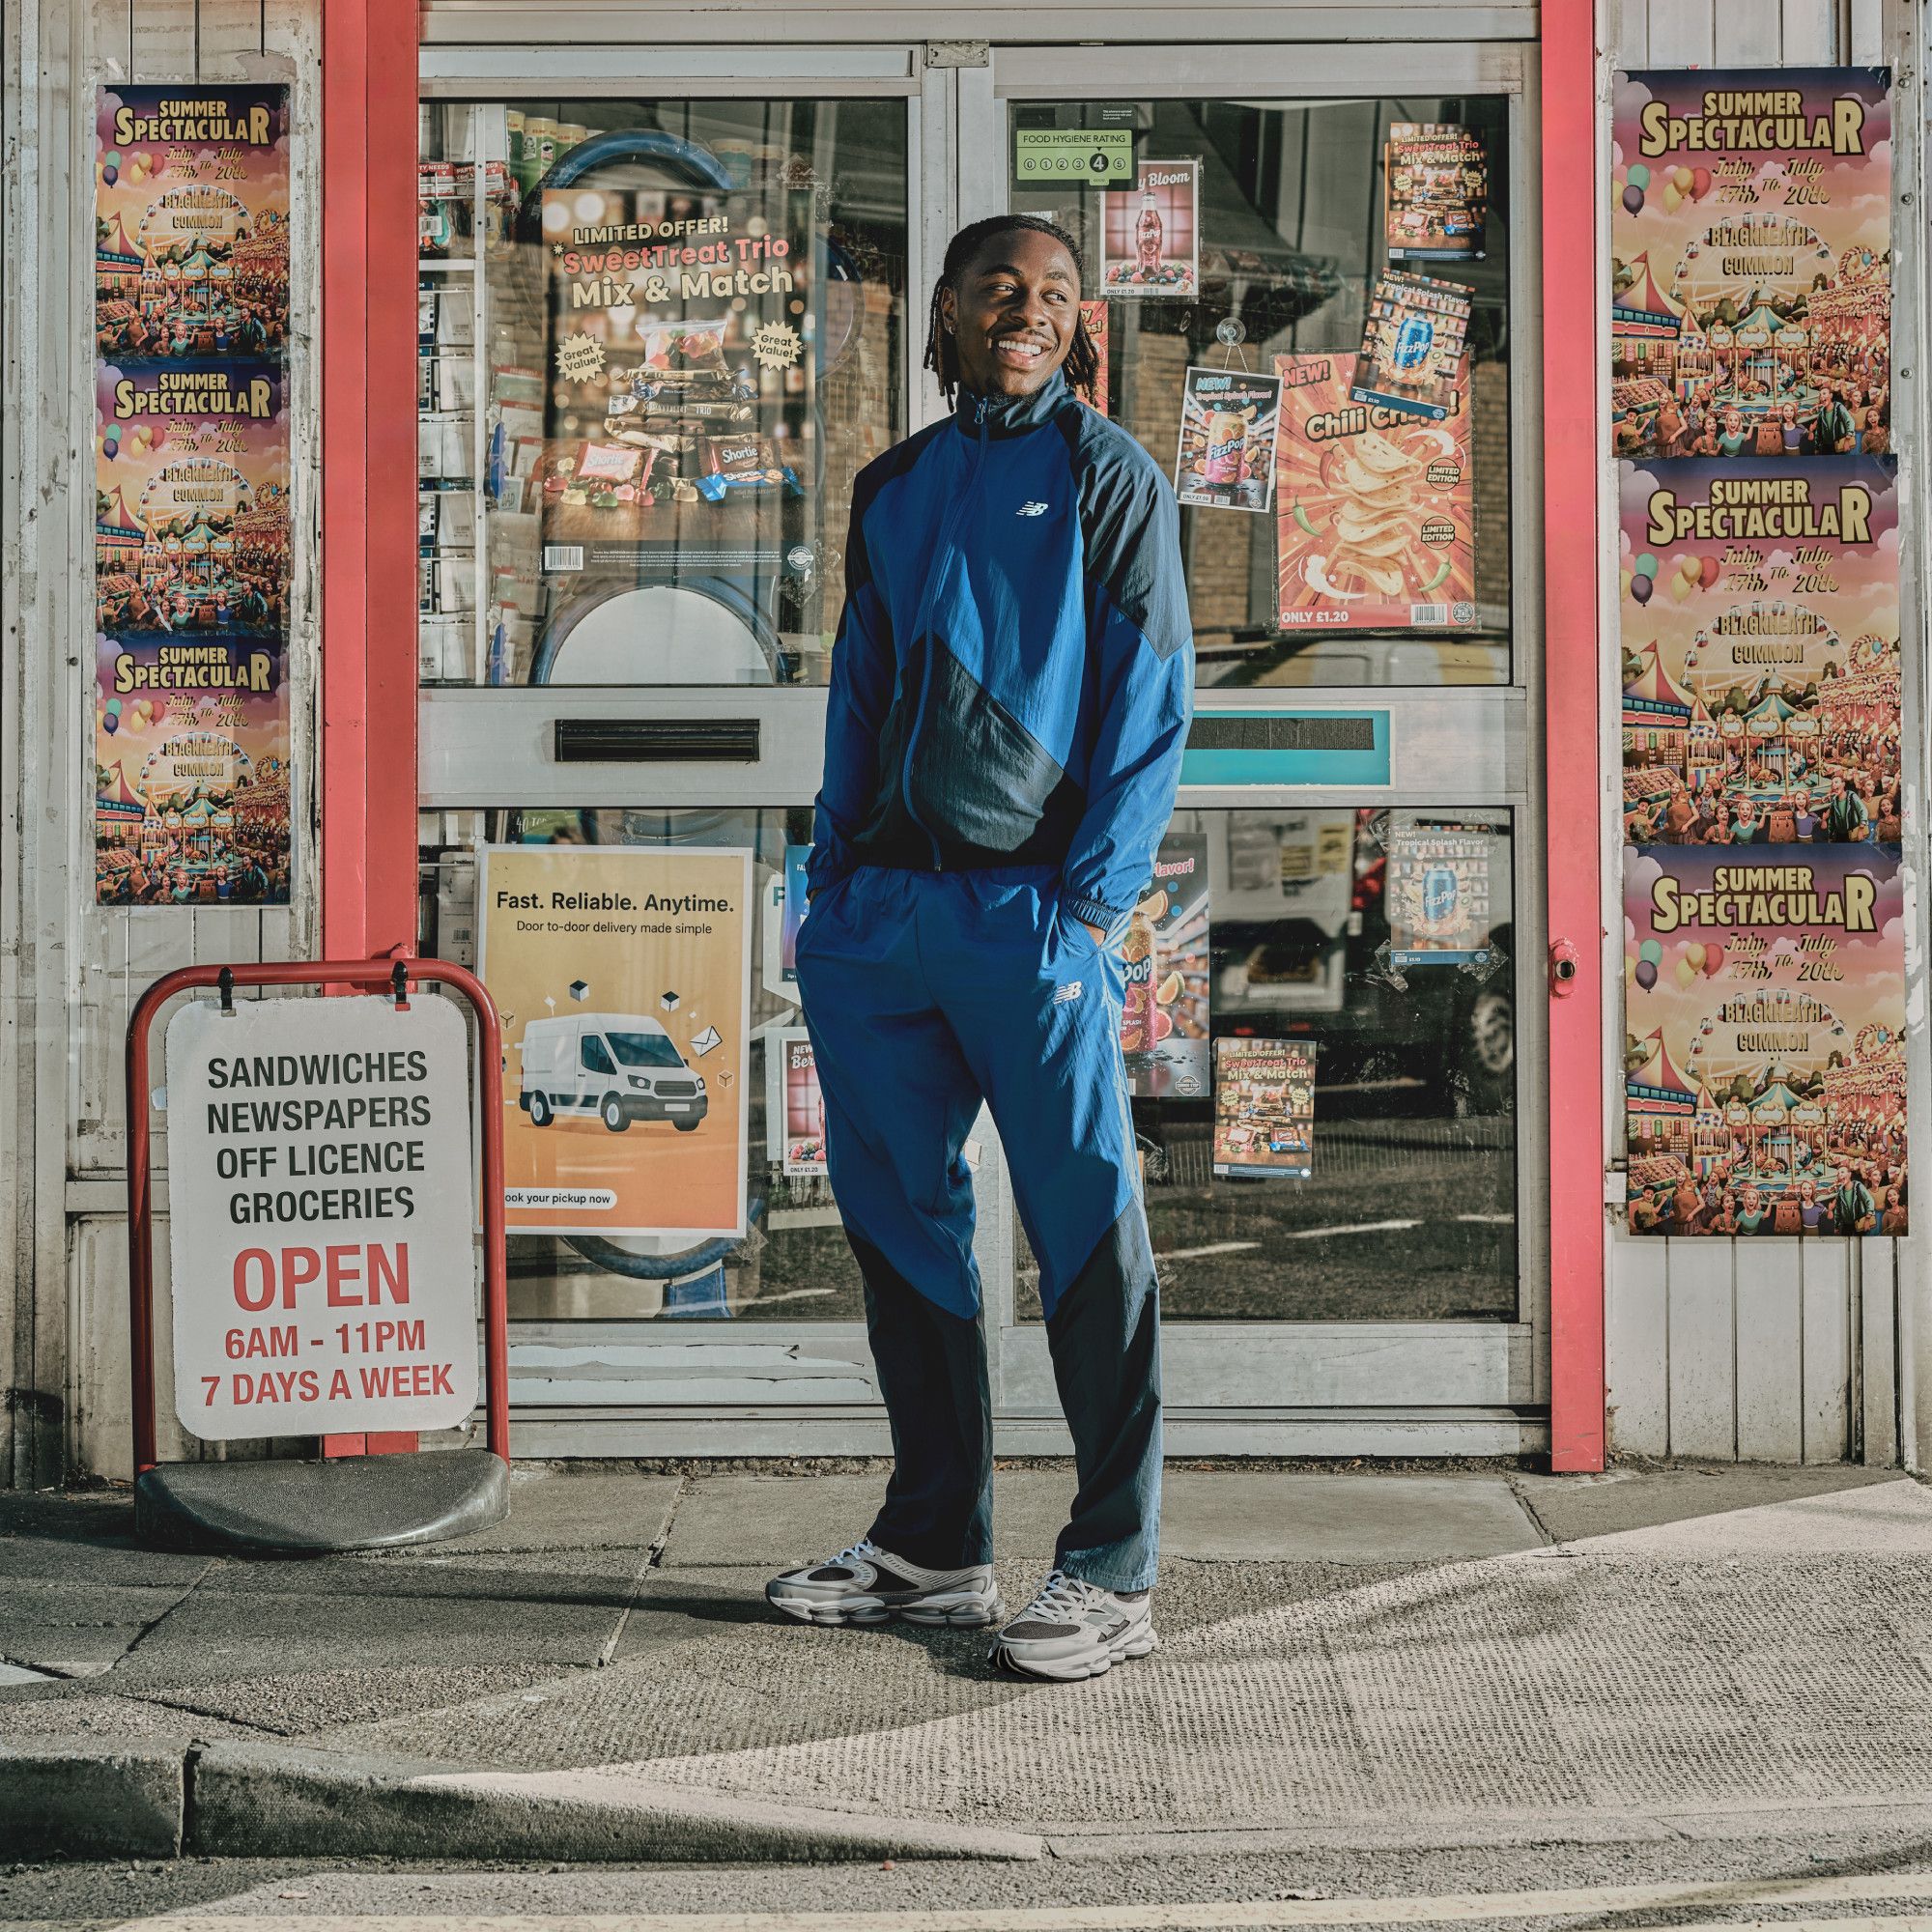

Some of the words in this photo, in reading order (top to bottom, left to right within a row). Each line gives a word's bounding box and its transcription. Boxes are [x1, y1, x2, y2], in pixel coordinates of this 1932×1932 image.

[159, 100, 227, 118] SUMMER
[1704, 91, 1803, 116] SUMMER
[115, 106, 271, 146] SPECTACULAR
[1639, 99, 1865, 158] SPECTACULAR
[1093, 134, 1125, 143] RATING
[1093, 156, 1105, 170] 4
[1400, 155, 1423, 165] Mix
[1439, 152, 1480, 163] Match
[1149, 171, 1190, 186] Bloom
[573, 223, 652, 245] LIMITED
[658, 216, 729, 237] OFFER!
[563, 241, 729, 274] SweetTreat
[735, 234, 789, 261] Trio
[572, 276, 634, 309] Mix
[644, 275, 670, 303] &
[681, 265, 793, 300] Match
[1382, 272, 1405, 283] NEW!
[1383, 281, 1415, 296] Tropical
[1417, 288, 1442, 301] Splash
[1444, 294, 1469, 305] Flavor
[758, 344, 793, 358] Value!
[761, 334, 792, 347] Great
[564, 346, 594, 360] Great
[565, 355, 601, 371] Value!
[159, 373, 228, 390] SUMMER
[1195, 376, 1232, 390] NEW!
[1283, 360, 1330, 387] NEW!
[115, 379, 272, 419] SPECTACULAR
[1306, 406, 1367, 442] Chili
[723, 446, 758, 464] Shortie
[1427, 474, 1460, 484] EDITION
[1428, 466, 1461, 475] LIMITED
[1711, 479, 1809, 505] SUMMER
[1647, 486, 1873, 547] SPECTACULAR
[1422, 525, 1455, 533] LIMITED
[1422, 532, 1455, 542] EDITION
[1281, 611, 1313, 624] ONLY
[1316, 611, 1350, 623] £1.20
[159, 646, 228, 665] SUMMER
[115, 653, 272, 694] SPECTACULAR
[1154, 857, 1195, 878] lavor!
[1714, 867, 1814, 893] SUMMER
[497, 891, 544, 909] Fast.
[552, 892, 638, 911] Reliable.
[644, 894, 734, 916] Anytime.
[1651, 873, 1879, 934] SPECTACULAR
[517, 920, 543, 932] Door
[548, 921, 590, 933] to-door
[592, 921, 638, 935] delivery
[640, 923, 672, 934] made
[674, 923, 712, 936] simple
[208, 1050, 428, 1089] SANDWICHES
[791, 1054, 815, 1069] Ber
[1228, 1070, 1251, 1081] Mix
[1266, 1068, 1307, 1080] Match
[207, 1094, 431, 1134] NEWSPAPERS
[216, 1147, 277, 1179] OFF
[288, 1140, 425, 1177] LICENCE
[230, 1186, 414, 1224] GROCERIES
[505, 1192, 524, 1203] ook
[526, 1194, 550, 1206] your
[552, 1192, 586, 1207] pickup
[588, 1195, 611, 1205] now
[233, 1242, 410, 1312] OPEN
[225, 1325, 298, 1360] 6AM
[335, 1320, 426, 1353] 11PM
[201, 1376, 221, 1406] 7
[233, 1370, 320, 1406] DAYS
[328, 1369, 353, 1402] A
[359, 1363, 455, 1399] WEEK
